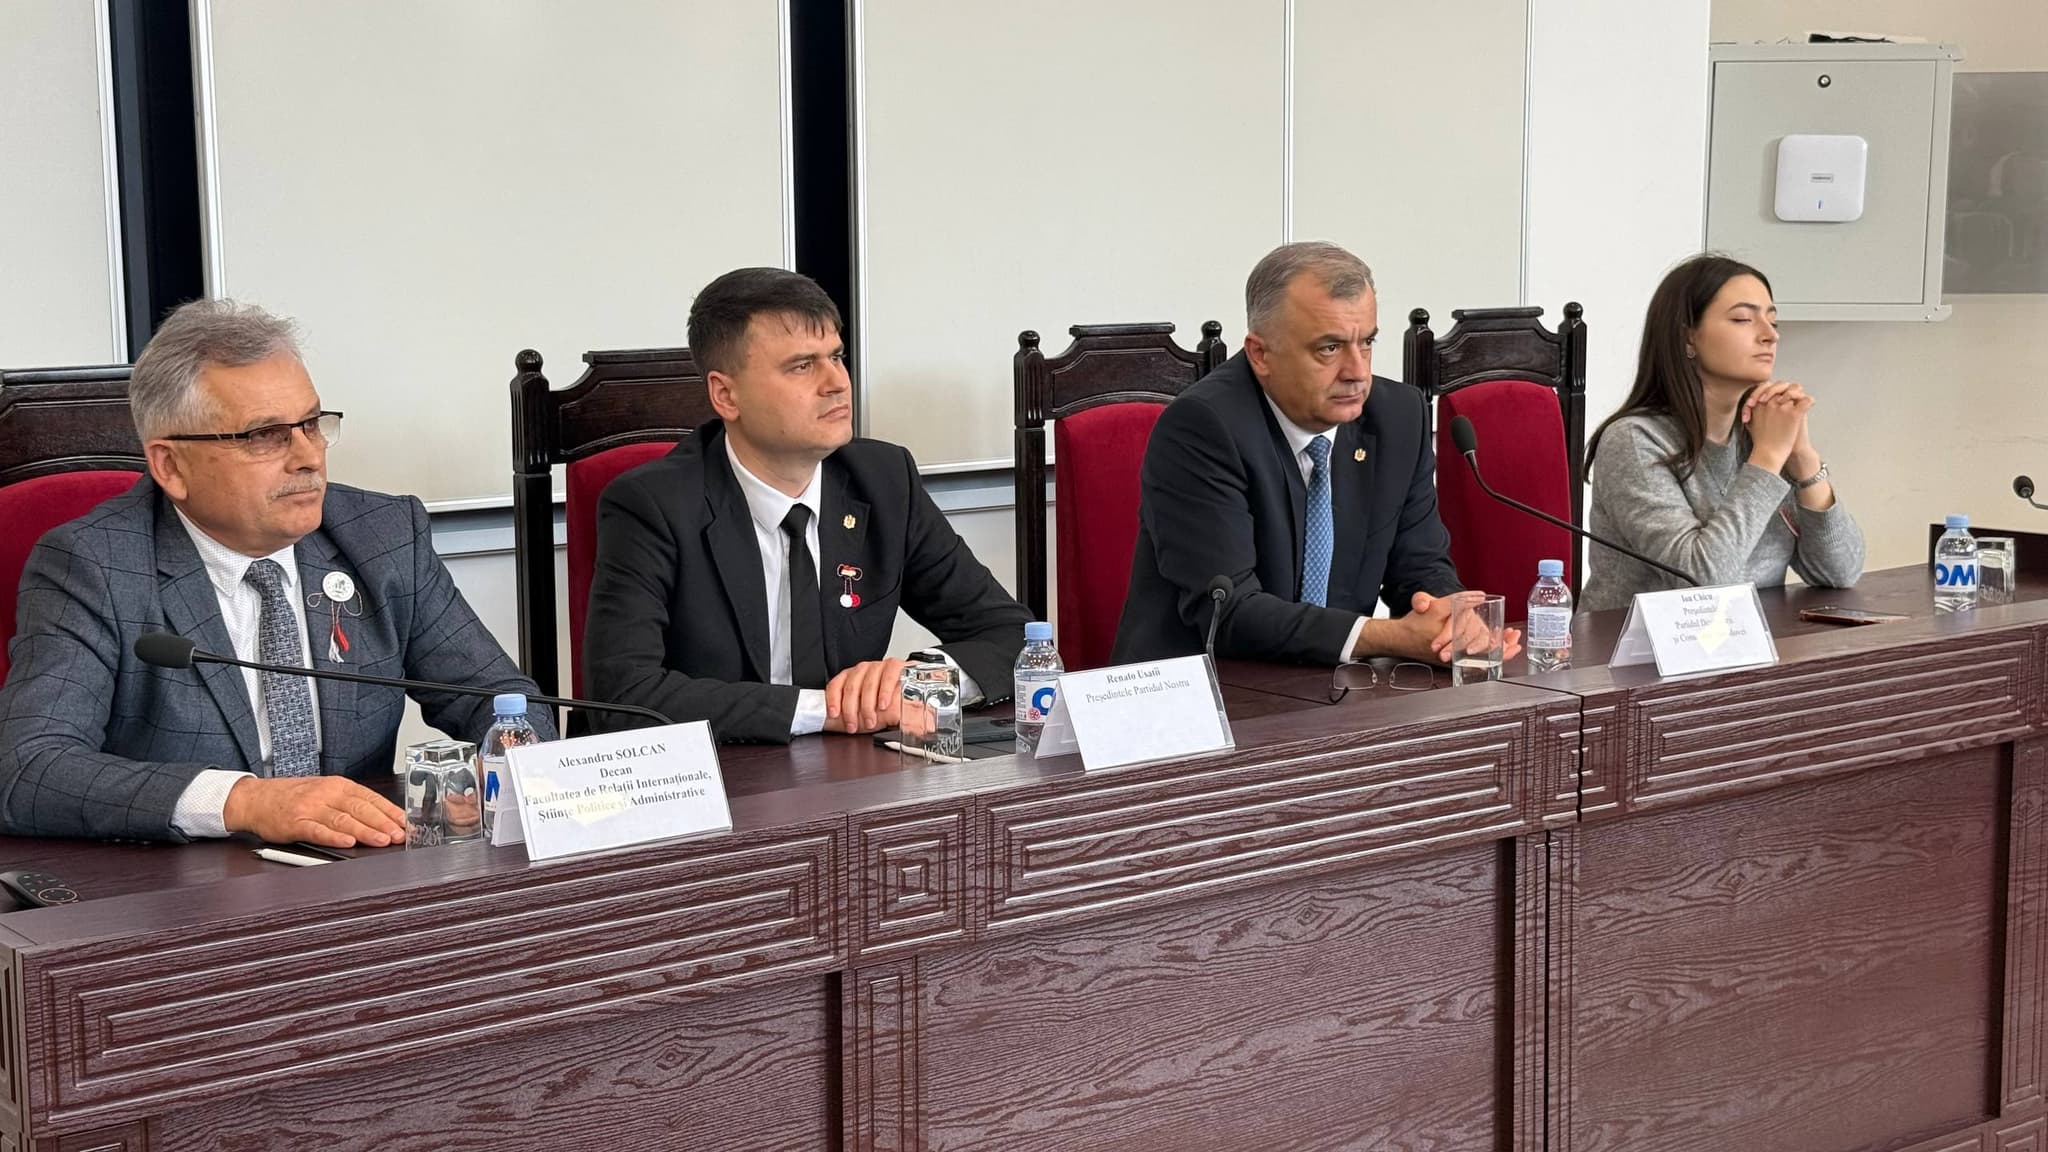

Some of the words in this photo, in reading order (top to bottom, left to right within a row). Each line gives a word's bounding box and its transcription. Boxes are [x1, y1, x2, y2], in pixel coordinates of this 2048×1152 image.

[1106, 672, 1136, 684] Renato
[1133, 681, 1163, 697] Partidul
[1164, 678, 1190, 691] Nostru
[557, 752, 614, 769] Alexandru
[615, 743, 667, 760] SOLCAN
[600, 765, 633, 779] Decan
[525, 788, 582, 806] Facultatea
[583, 785, 597, 798] de
[629, 787, 705, 807] Administrative
